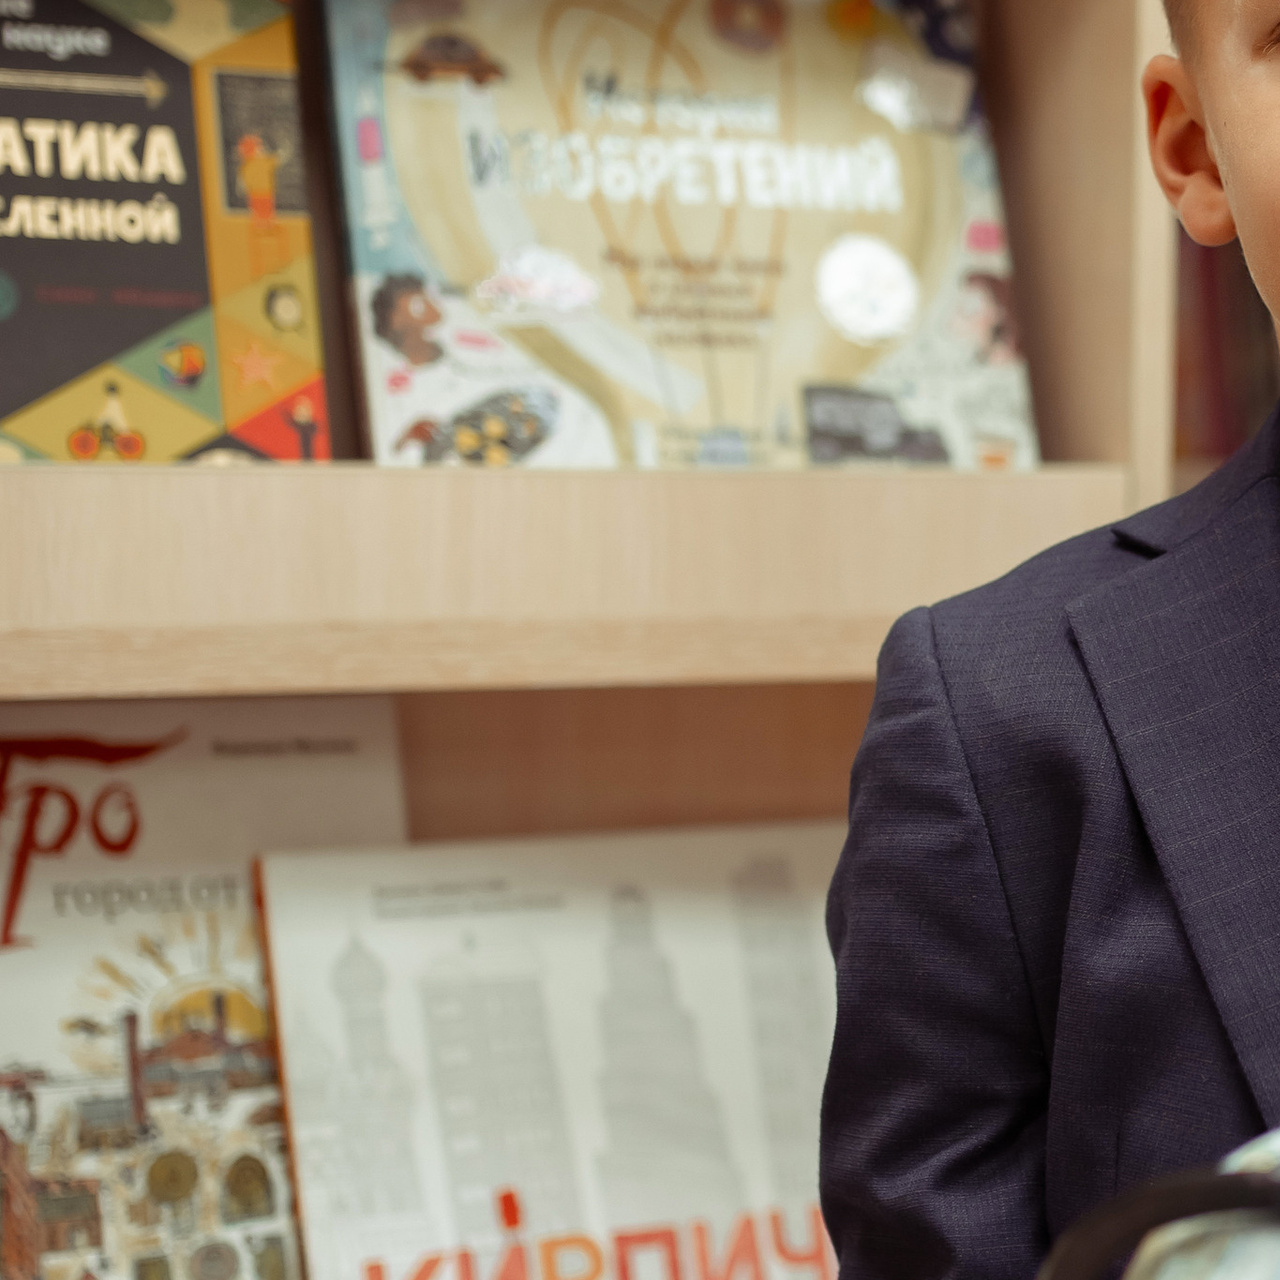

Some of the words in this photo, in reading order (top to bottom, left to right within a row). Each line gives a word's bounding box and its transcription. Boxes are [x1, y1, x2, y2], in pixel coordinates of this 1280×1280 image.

[3, 22, 111, 60] науке
[0, 116, 187, 185] АТИКА
[0, 191, 182, 244] ЛЕННОЙ
